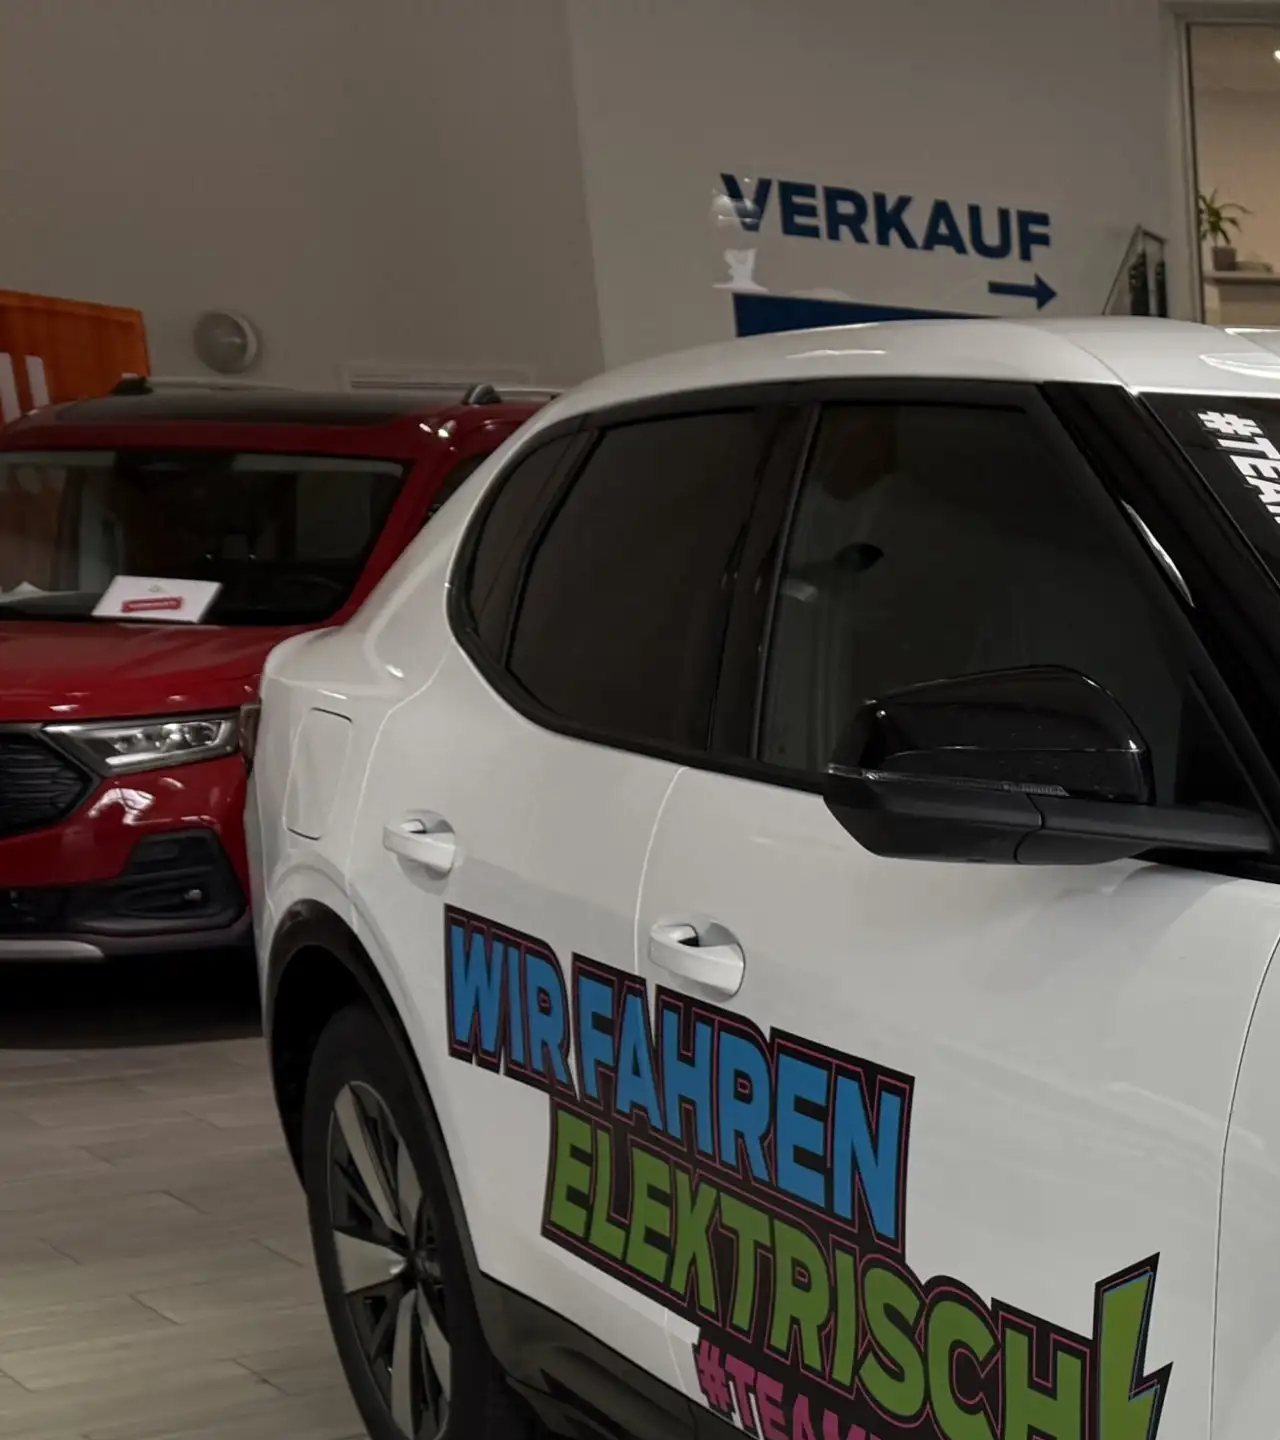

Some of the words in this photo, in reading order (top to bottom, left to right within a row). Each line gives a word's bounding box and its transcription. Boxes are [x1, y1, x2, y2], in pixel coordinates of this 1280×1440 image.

[720, 172, 1052, 262] VERKAUF
[449, 922, 575, 1085] WIR
[573, 972, 903, 1240] FAHREN
